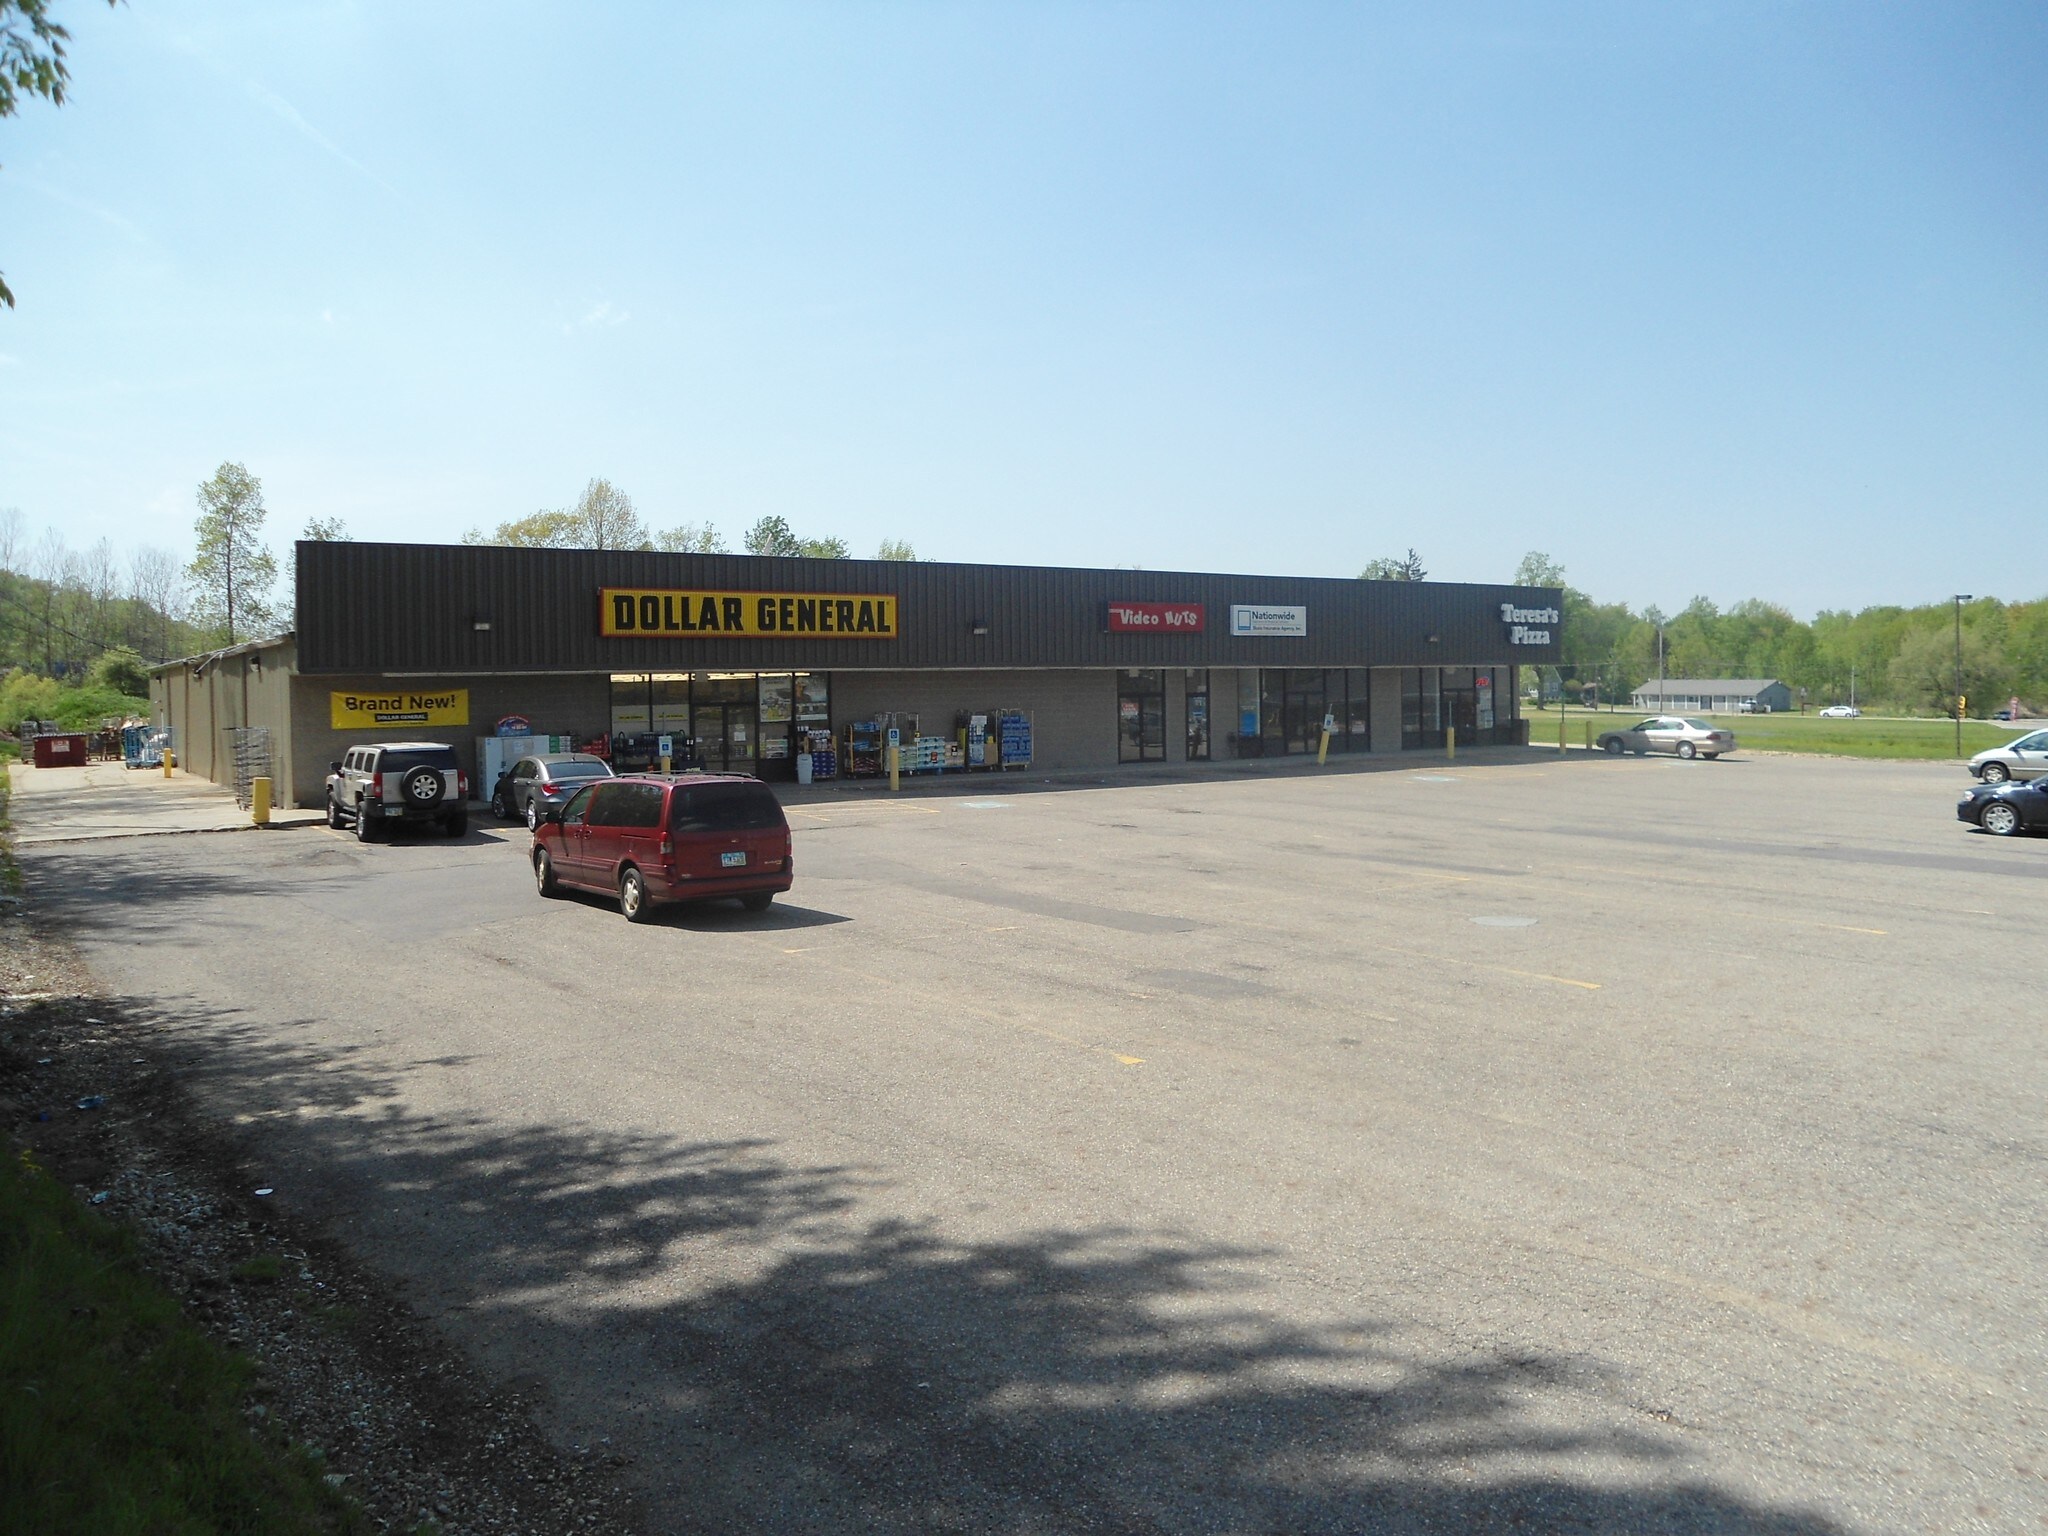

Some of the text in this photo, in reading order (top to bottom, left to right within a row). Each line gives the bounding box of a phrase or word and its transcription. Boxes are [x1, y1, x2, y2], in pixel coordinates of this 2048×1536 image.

[613, 595, 891, 633] DOLLAR GENERAL
[1119, 609, 1198, 626] Video NUTS
[1252, 611, 1296, 620] Nationwide
[1501, 603, 1559, 624] Teresa's
[1511, 626, 1551, 645] Pizza
[345, 694, 456, 711] Brand New!
